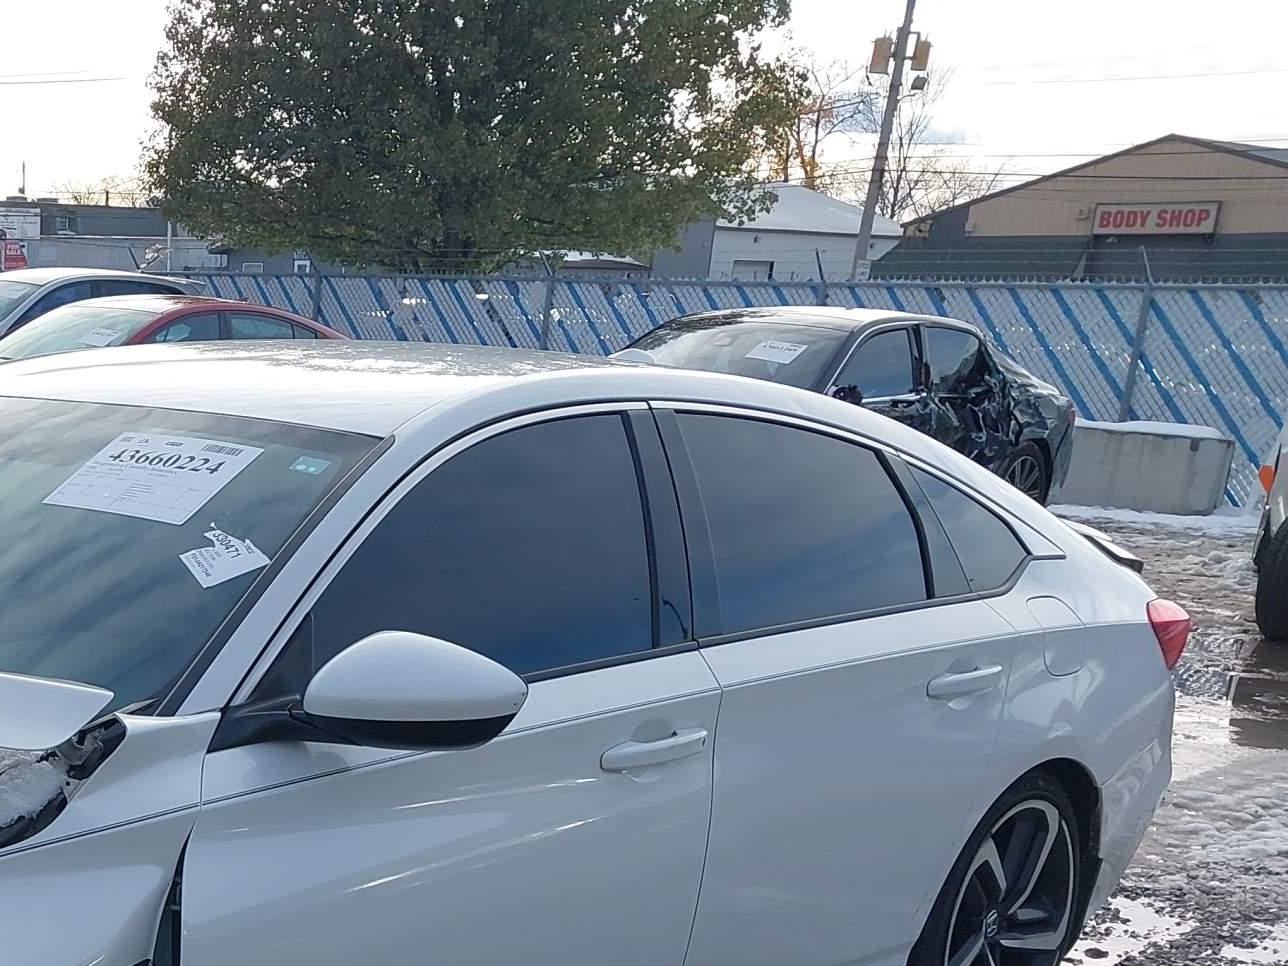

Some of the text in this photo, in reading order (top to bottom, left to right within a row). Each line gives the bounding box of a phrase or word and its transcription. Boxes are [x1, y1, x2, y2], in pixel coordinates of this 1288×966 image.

[1098, 208, 1211, 229] BODY SHOP
[108, 447, 227, 475] 43660224
